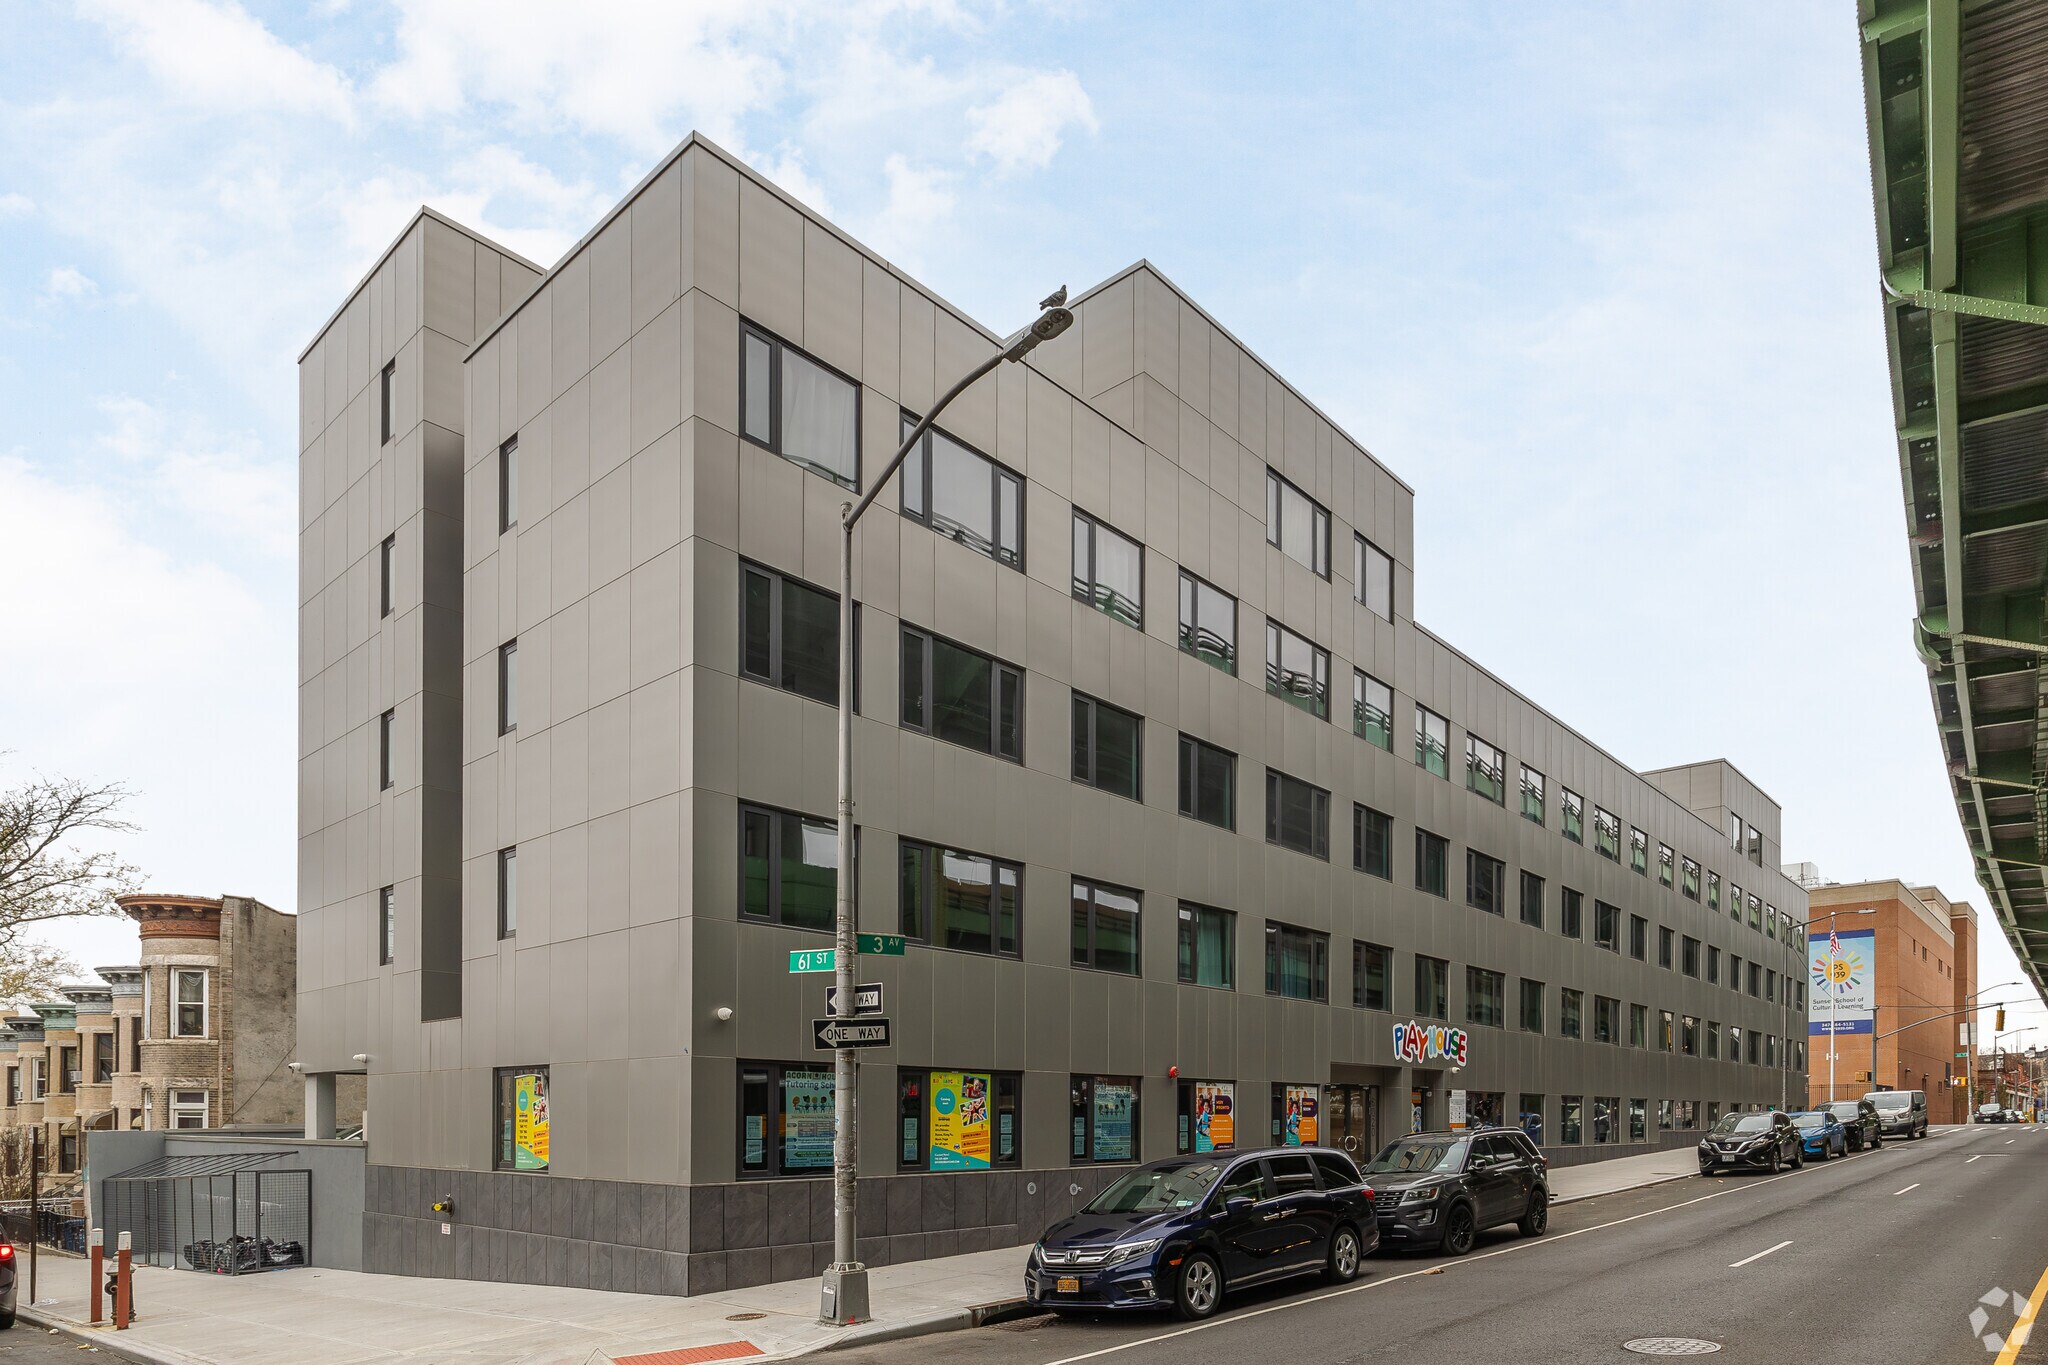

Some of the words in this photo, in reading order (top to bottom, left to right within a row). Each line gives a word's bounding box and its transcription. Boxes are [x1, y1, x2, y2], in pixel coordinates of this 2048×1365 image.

[873, 936, 883, 953] 3
[888, 937, 900, 947] AV
[798, 953, 811, 970] 61
[816, 952, 828, 964] ST
[857, 993, 875, 1005] WAY
[826, 1028, 848, 1040] ONE
[858, 1027, 881, 1039] WAY
[1394, 1021, 1467, 1065] PLAYHOUSE
[786, 1071, 812, 1080] ACORN
[786, 1080, 819, 1091] Tutoring
